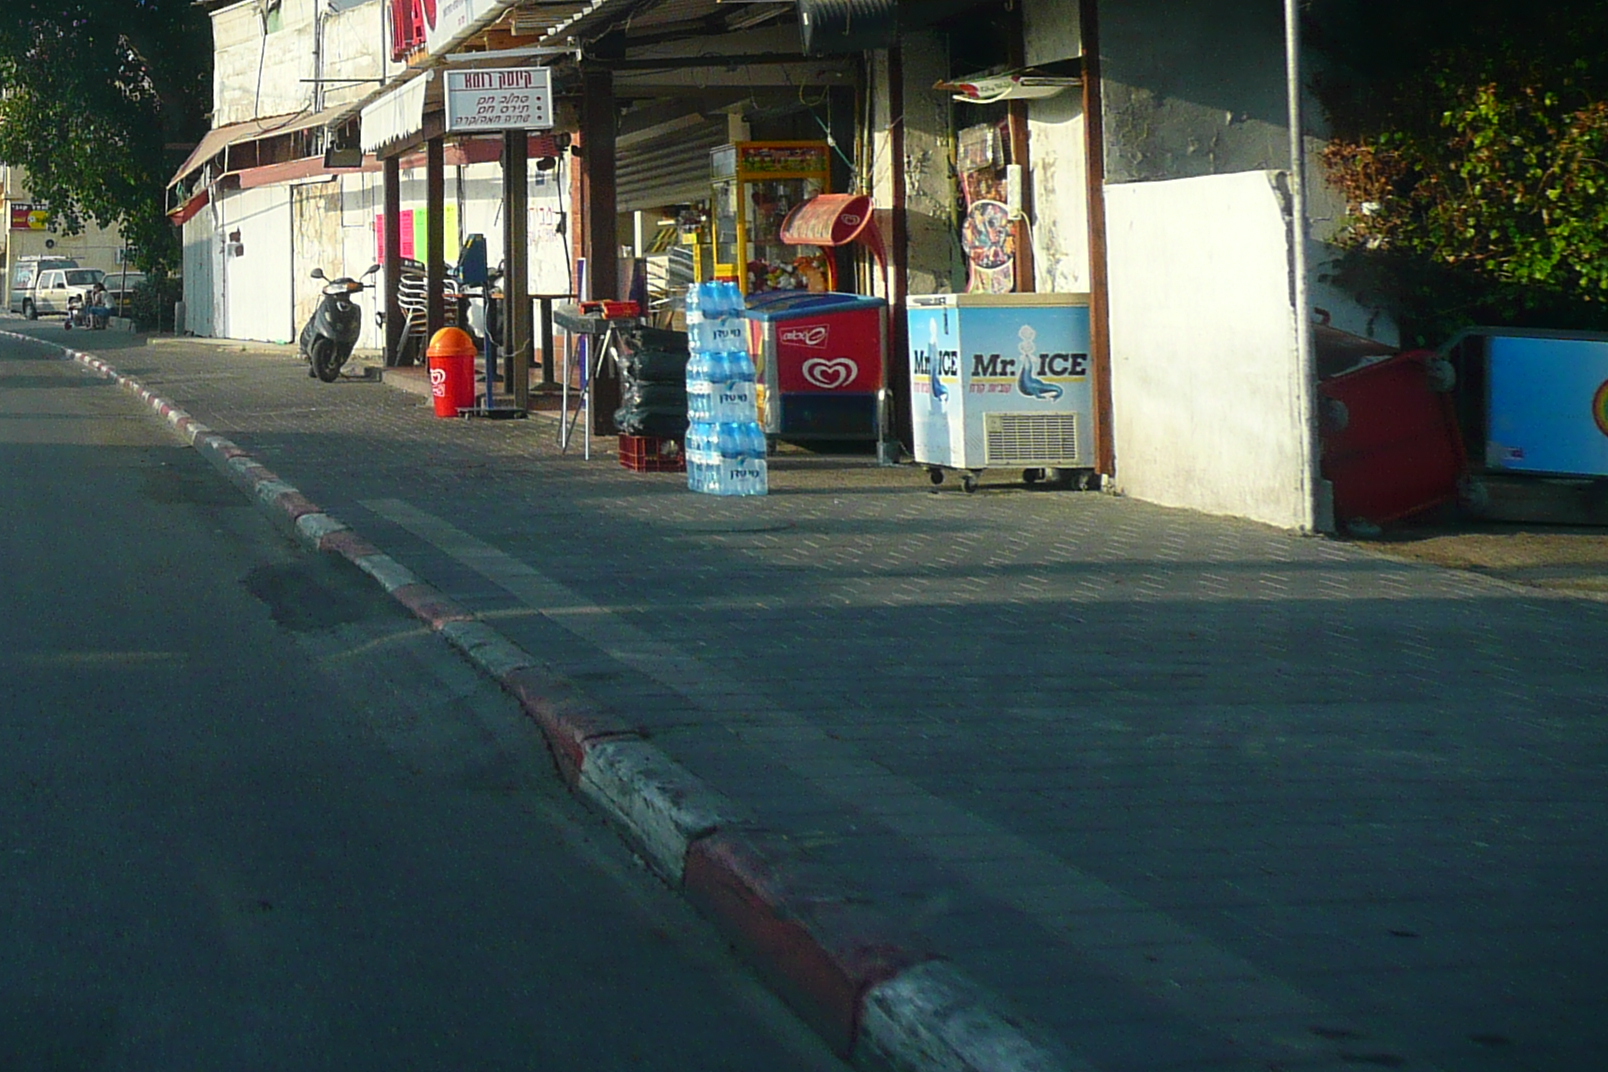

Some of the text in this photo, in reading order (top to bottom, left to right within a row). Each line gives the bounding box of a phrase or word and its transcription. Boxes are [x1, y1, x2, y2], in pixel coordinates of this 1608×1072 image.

[464, 70, 532, 89] קיוסק רומא
[938, 350, 958, 376] ICE
[971, 353, 1088, 377] Mr. ICE
